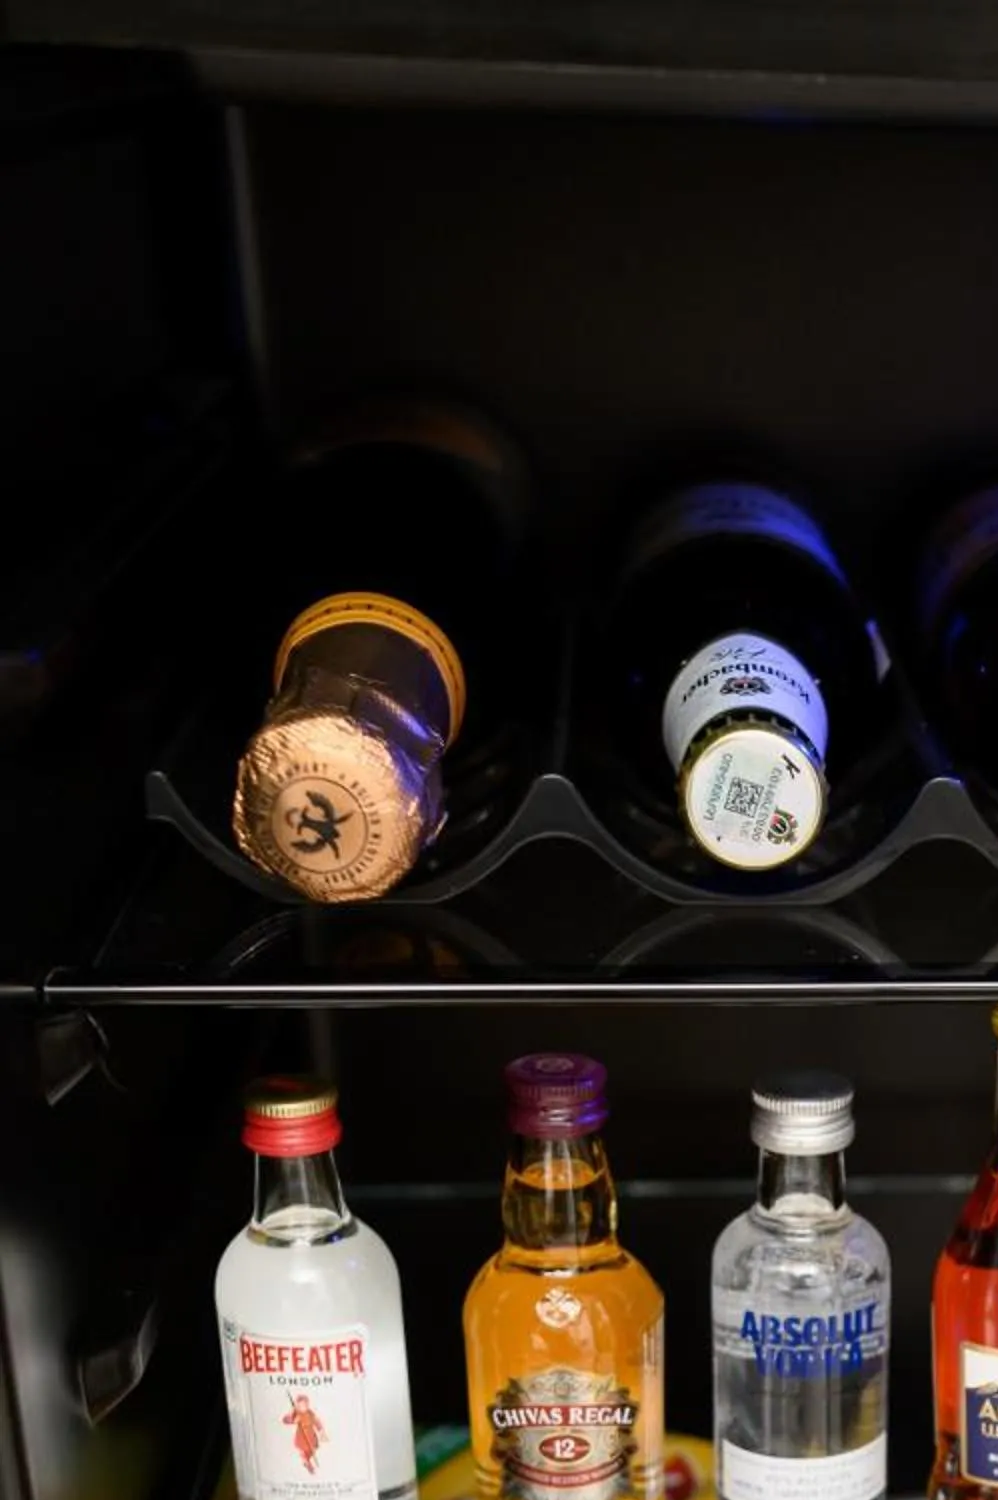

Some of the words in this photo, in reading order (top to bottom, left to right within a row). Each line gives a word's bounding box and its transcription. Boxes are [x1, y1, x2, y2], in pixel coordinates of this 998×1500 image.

[741, 1302, 878, 1345] ABSOLUT
[240, 1338, 364, 1374] BEEFEATER
[269, 1375, 334, 1386] LONDON
[493, 1407, 563, 1428] CHIVAS
[568, 1405, 633, 1426] REGAL
[553, 1438, 576, 1458] 12
